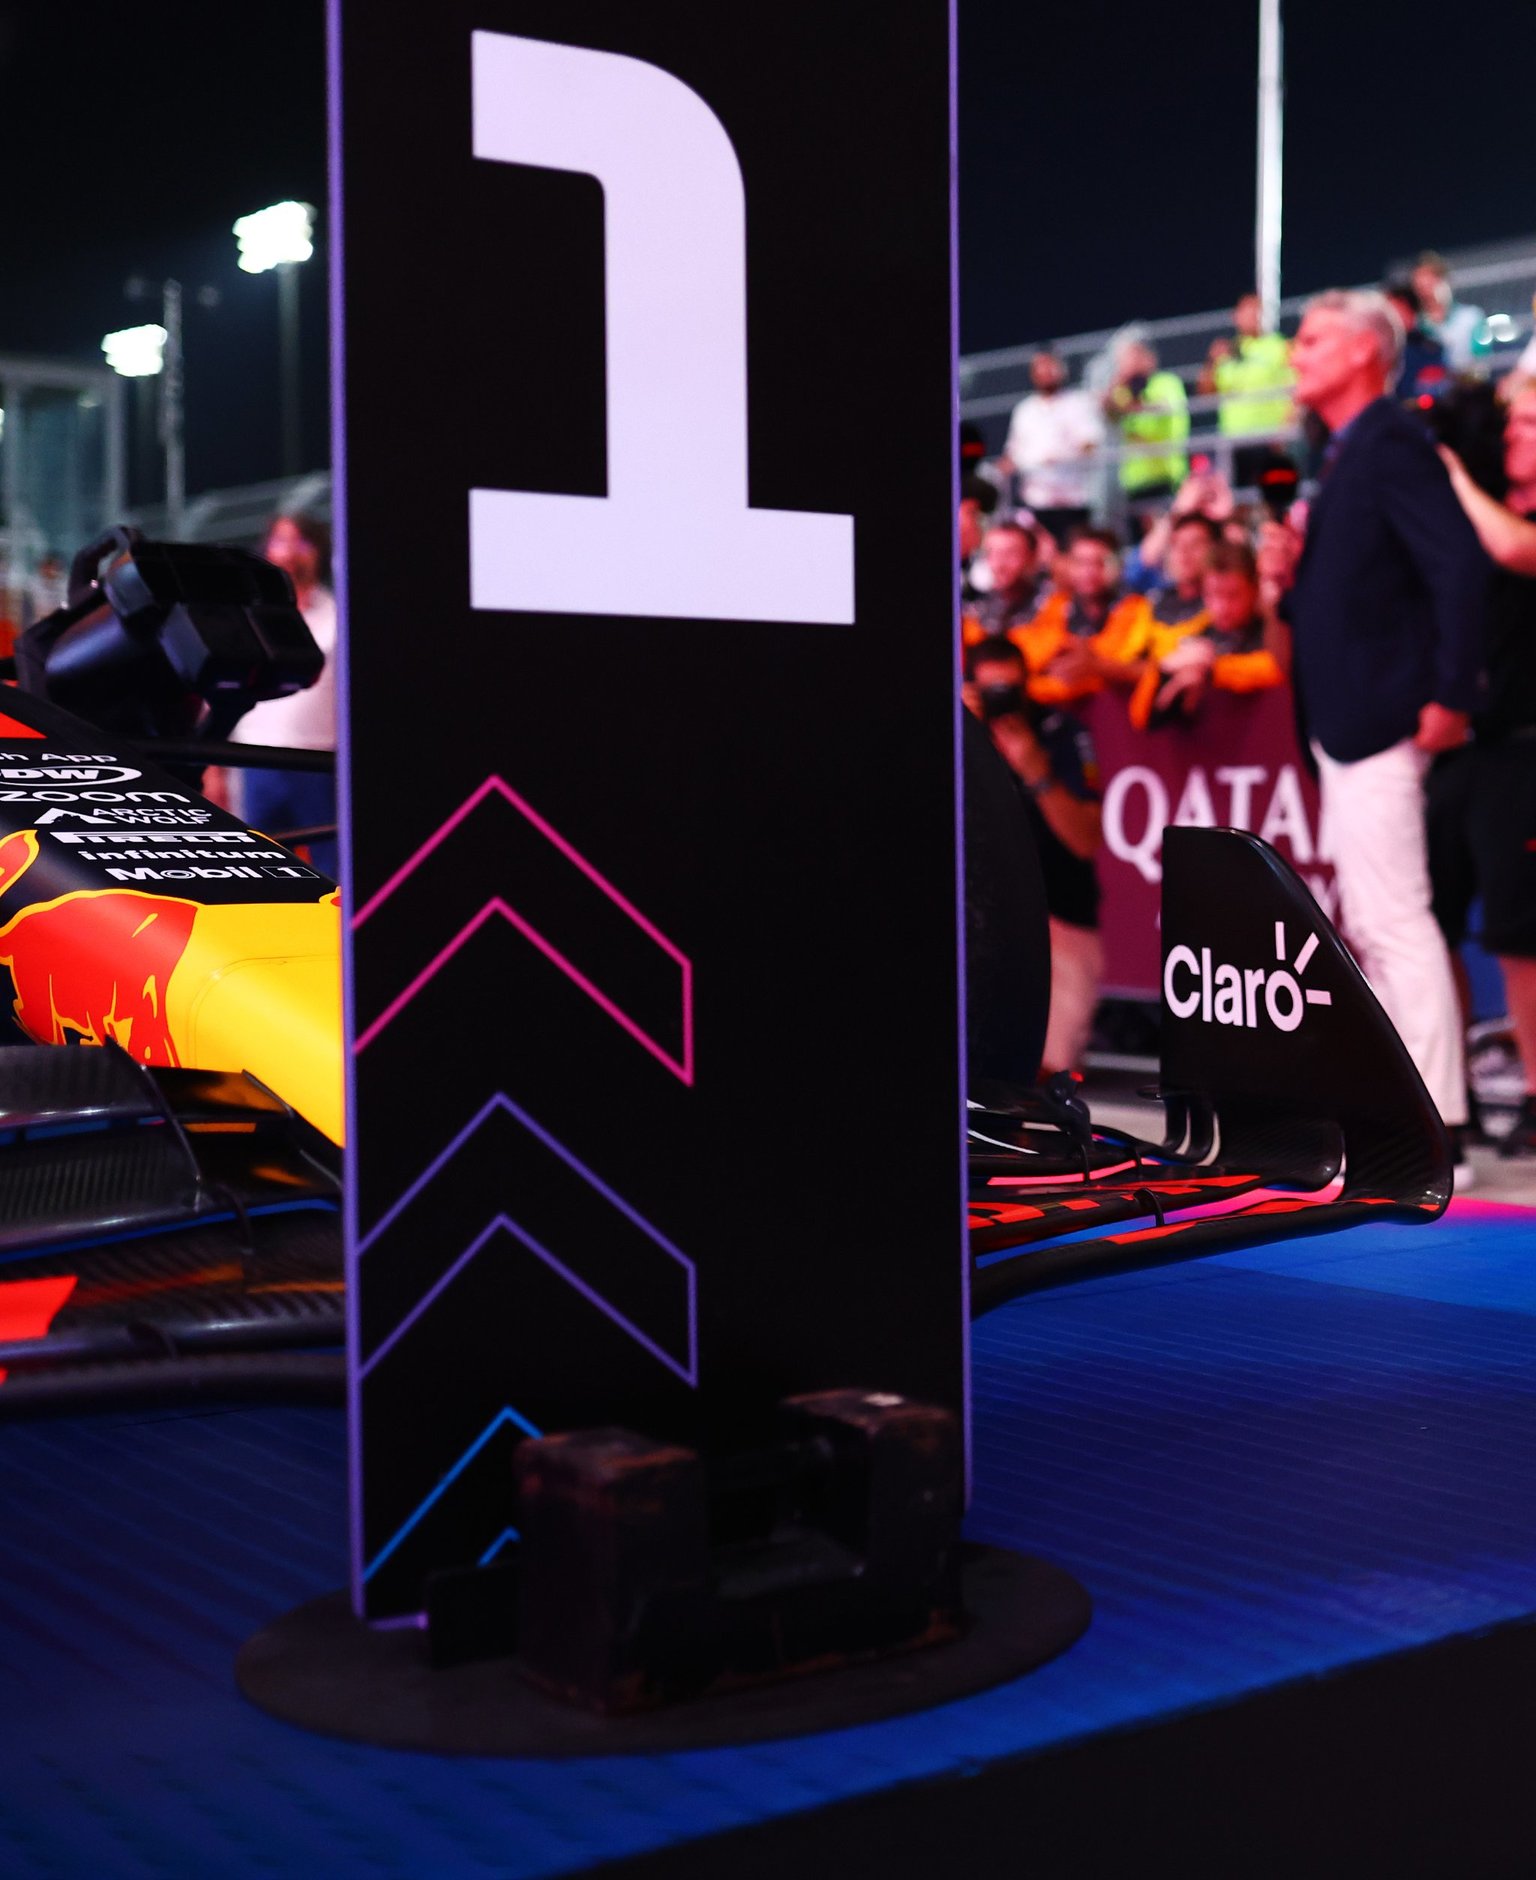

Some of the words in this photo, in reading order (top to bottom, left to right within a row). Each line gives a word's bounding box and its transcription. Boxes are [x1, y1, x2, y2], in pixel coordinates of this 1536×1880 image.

[469, 28, 855, 625] 1
[41, 753, 118, 763] App
[0, 768, 99, 780] DW
[0, 790, 191, 803] zoom
[92, 808, 213, 817] ARCTIC
[114, 815, 210, 825] WOLF
[1102, 765, 1334, 884] QATA
[50, 831, 256, 843] PIRELLI
[78, 849, 286, 861] infinitum
[105, 866, 263, 881] Mobil
[1164, 943, 1304, 1032] Claro
